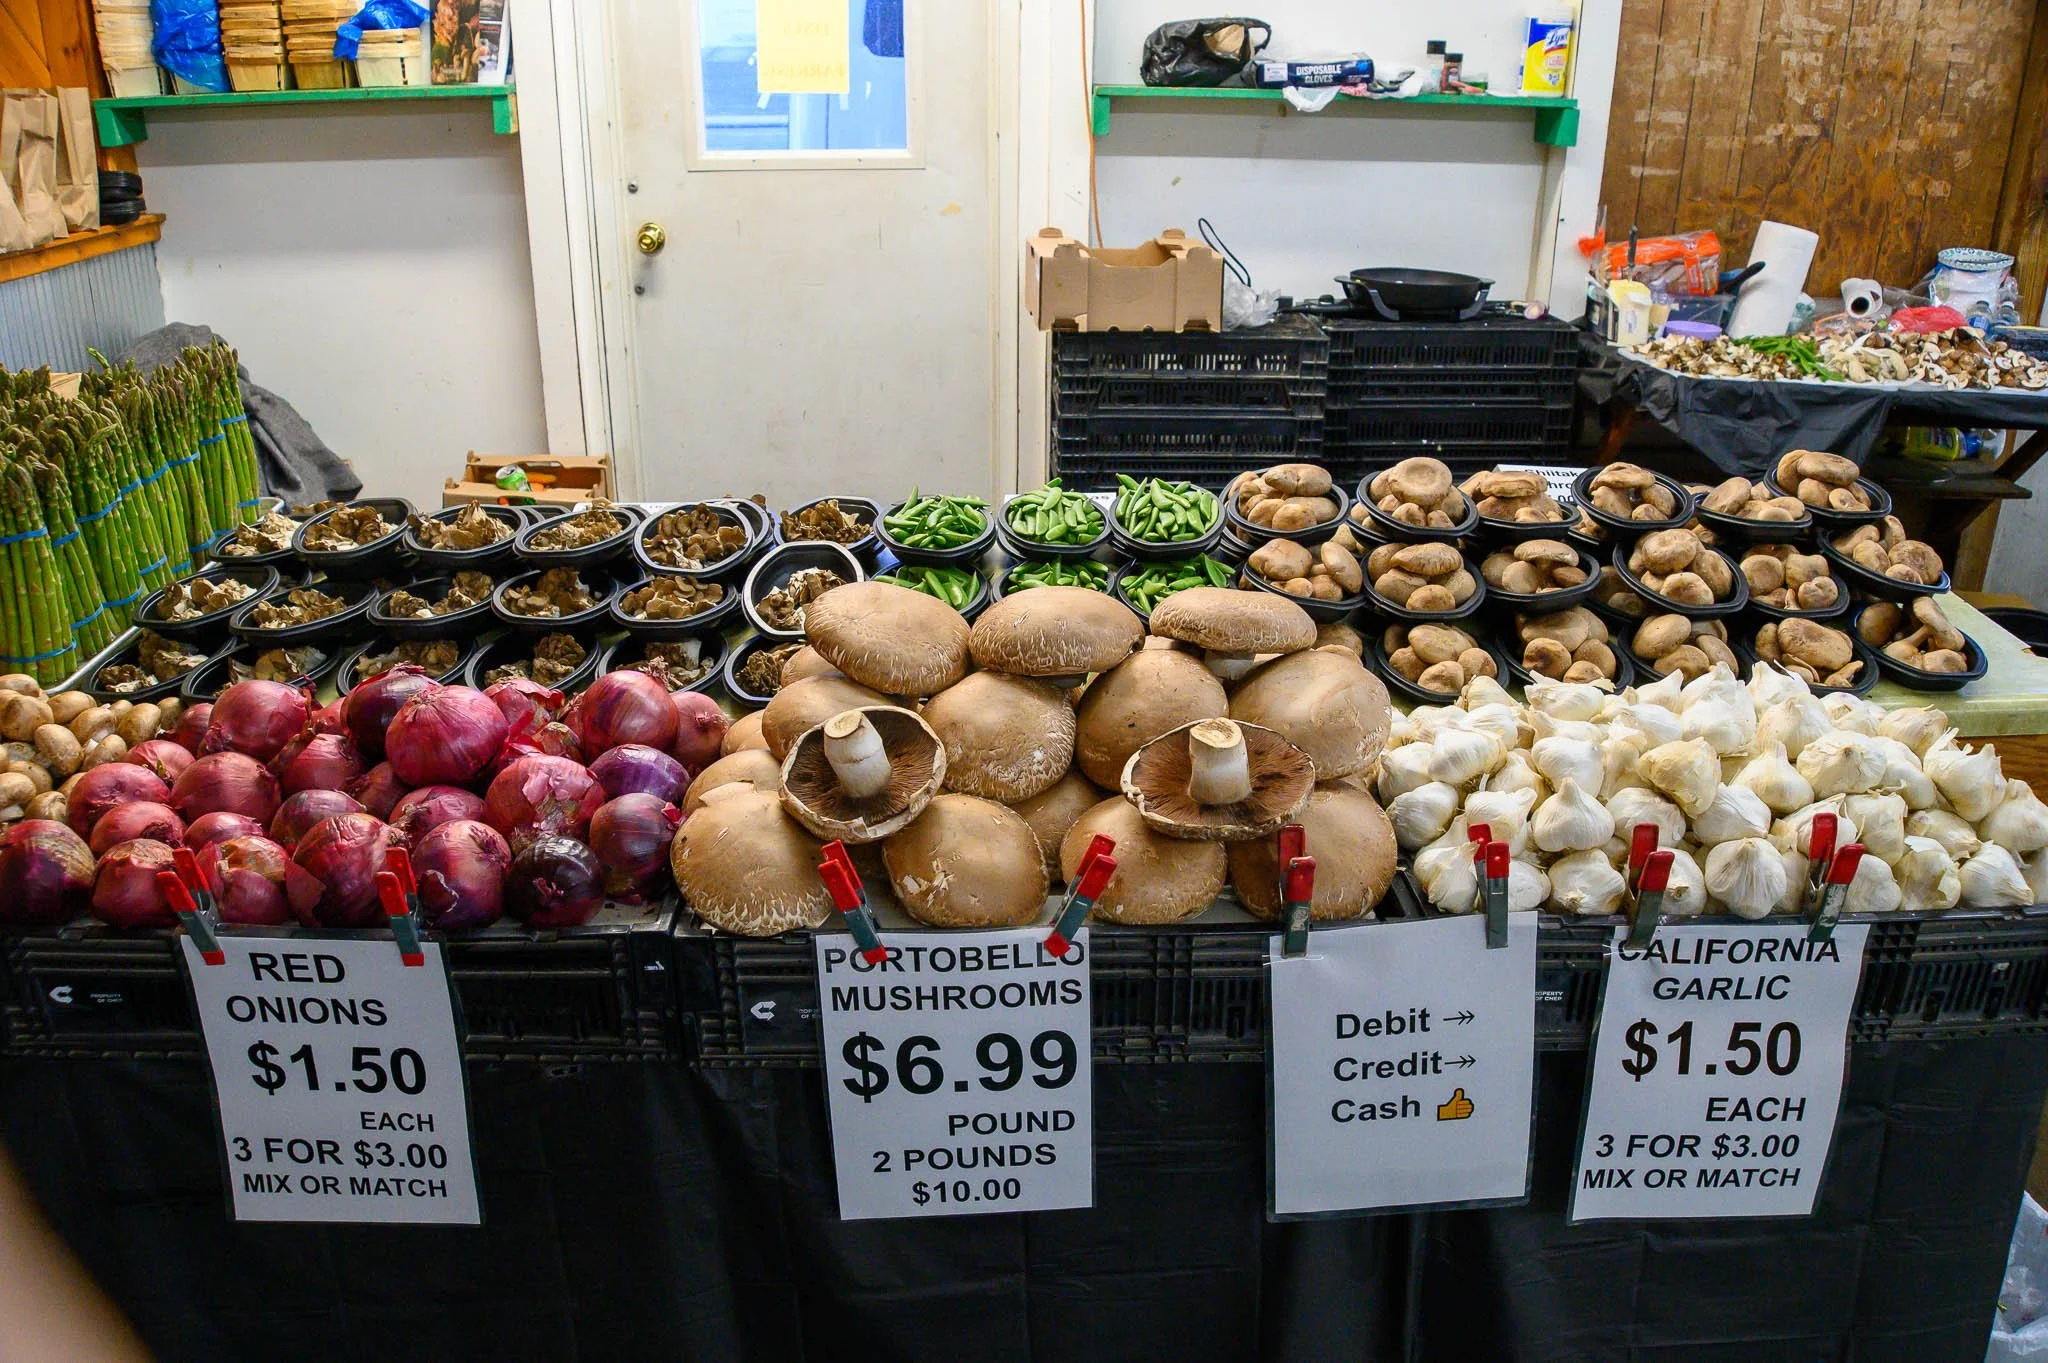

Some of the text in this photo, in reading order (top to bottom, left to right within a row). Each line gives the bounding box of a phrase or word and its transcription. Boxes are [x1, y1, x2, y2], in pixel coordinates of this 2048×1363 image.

[1296, 64, 1341, 75] DISPOSABLE
[1304, 74, 1334, 83] GLOVES
[824, 942, 1085, 974] PORTOBELLO
[1617, 938, 1841, 965] CALIFORNIA
[248, 952, 345, 983] RED
[832, 979, 1082, 1011] MUSHROOMS
[1653, 975, 1790, 1000] GARLIC
[226, 995, 387, 1026] ONIONS
[1337, 1008, 1430, 1039] Debit
[1622, 1018, 1801, 1082] $1.50
[248, 1040, 426, 1096] $1.50
[843, 1030, 1077, 1103] $6.99
[1333, 1050, 1442, 1082] Credit
[360, 1112, 434, 1132] EACH
[949, 1110, 1075, 1136] POUND
[1332, 1096, 1420, 1122] Cash
[1706, 1097, 1806, 1121] EACH
[233, 1137, 447, 1168] 3 FOR $3.00
[873, 1144, 1056, 1172] 2 POUNDS
[1596, 1133, 1799, 1160] 3 FOR $3.00
[243, 1174, 447, 1197] MIX OR MATCH
[913, 1178, 1020, 1206] $10.00
[1584, 1168, 1800, 1188] MIX OR MATCH
